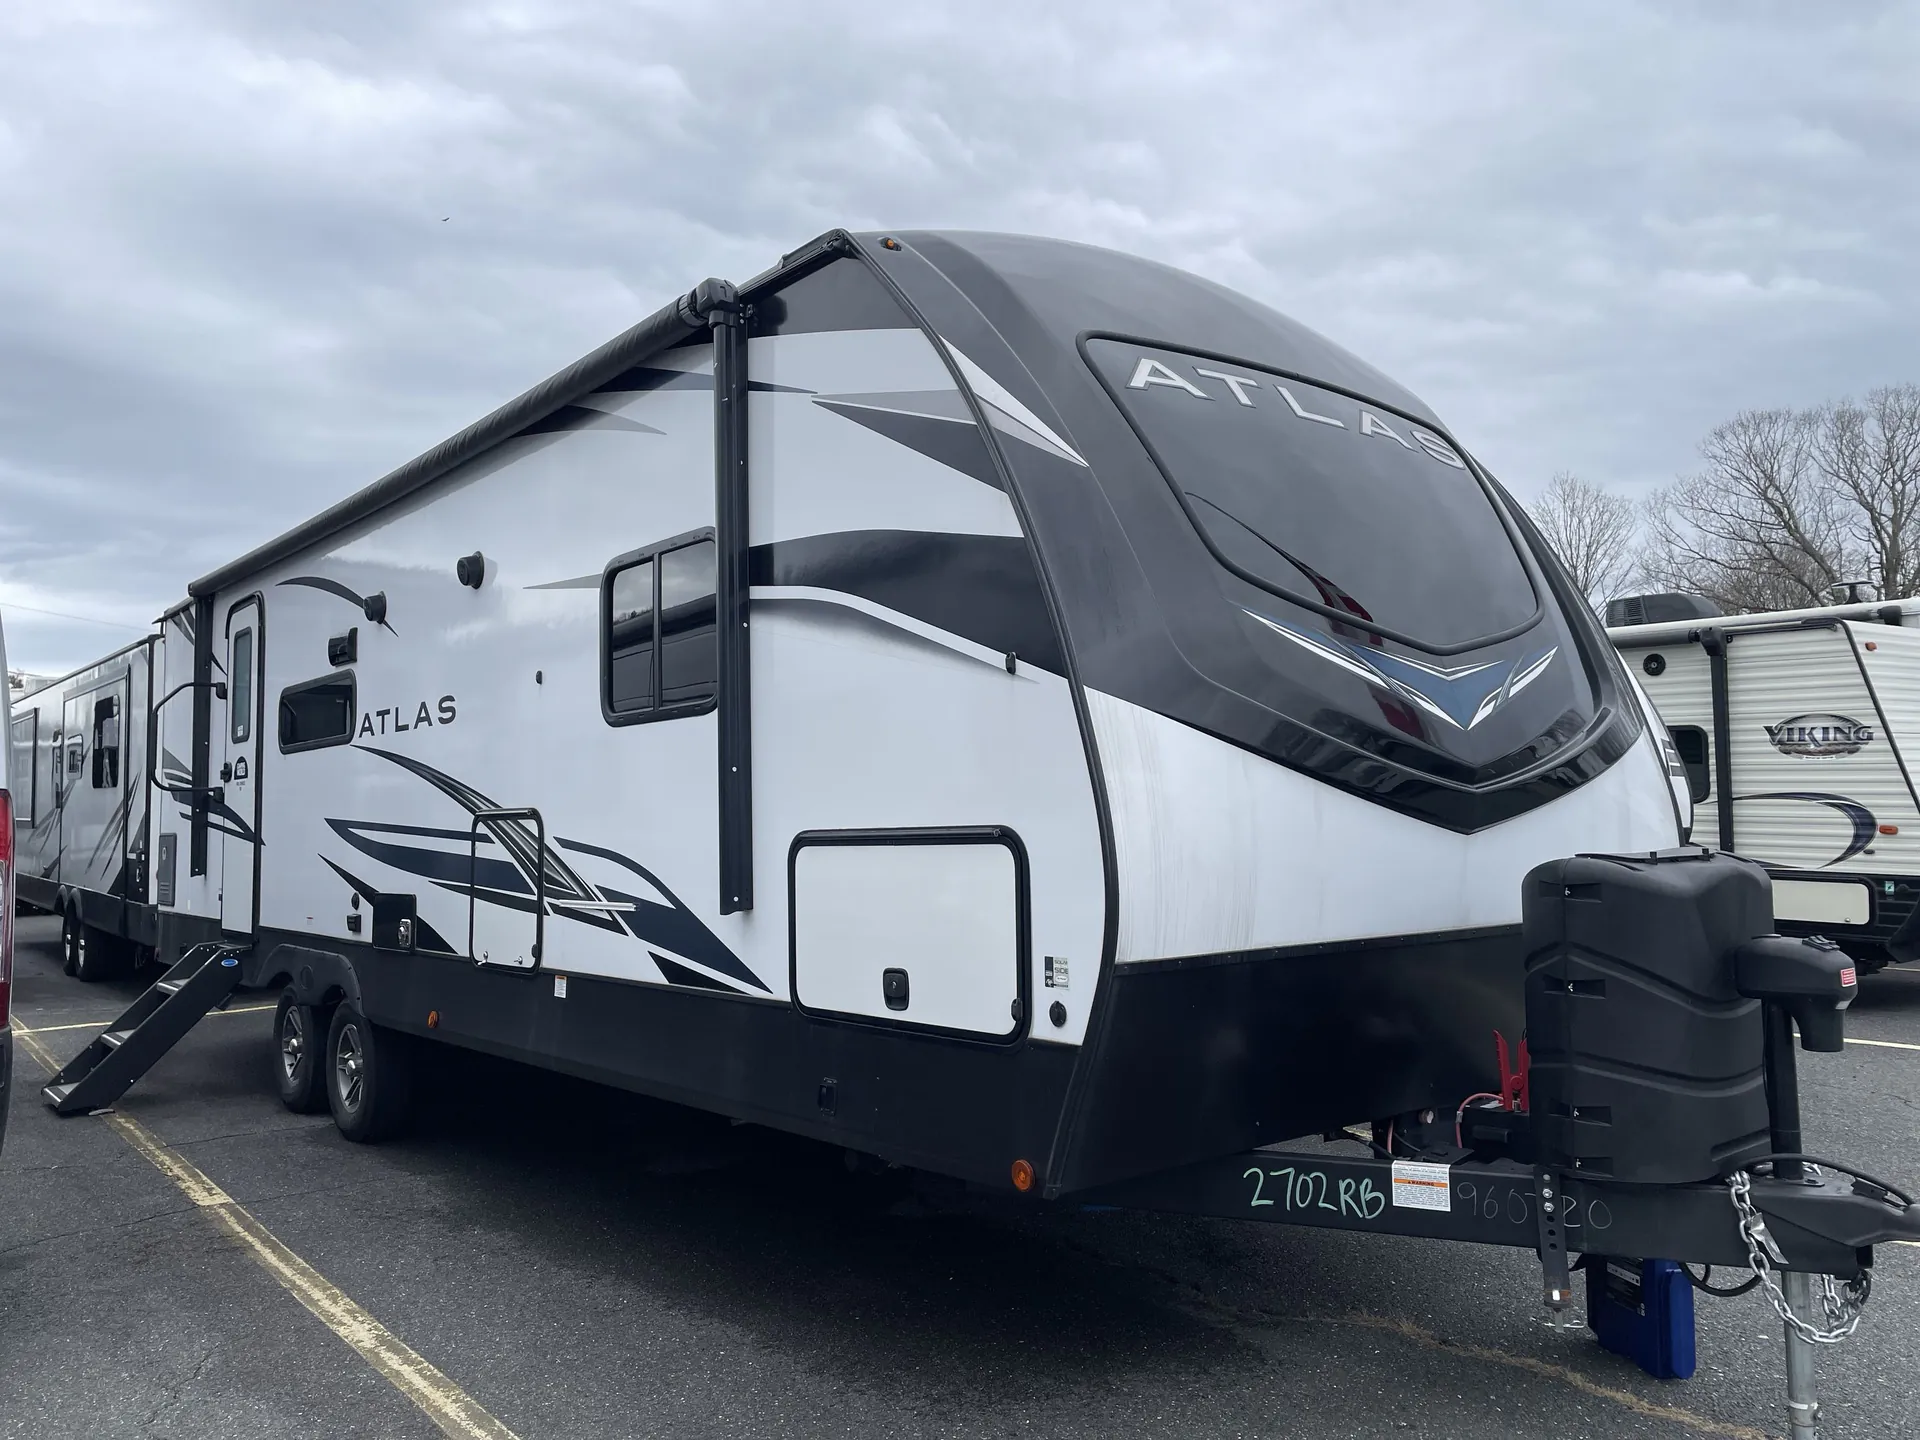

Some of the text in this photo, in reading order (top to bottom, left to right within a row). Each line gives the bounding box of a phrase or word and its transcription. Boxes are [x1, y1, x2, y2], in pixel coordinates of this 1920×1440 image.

[1126, 357, 1465, 470] ATLAS
[358, 695, 456, 738] ATLAS
[1762, 725, 1875, 747] VIKING
[1243, 1167, 1385, 1219] 2702RB
